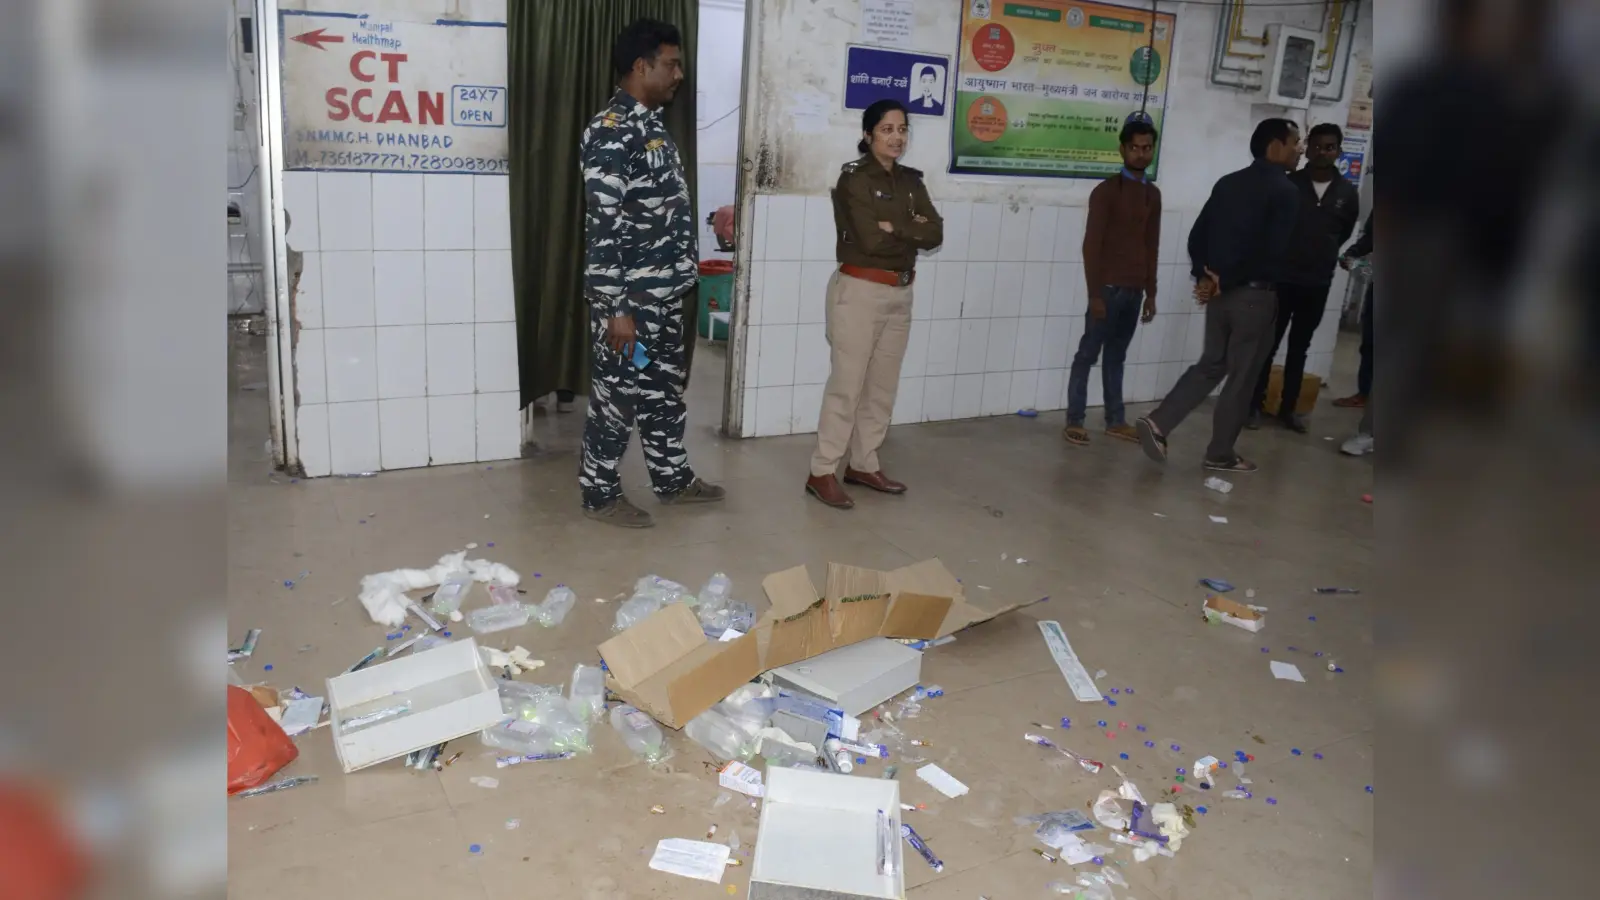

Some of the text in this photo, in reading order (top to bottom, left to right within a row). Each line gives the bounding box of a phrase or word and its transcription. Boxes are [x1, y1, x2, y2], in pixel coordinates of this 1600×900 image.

[352, 32, 402, 52] Healthmap
[349, 50, 408, 84] CT
[850, 73, 869, 84] शांति
[460, 89, 499, 102] 24X7
[325, 87, 444, 125] SCAN
[460, 109, 493, 122] OPEN
[376, 132, 454, 149] DHANBAD
